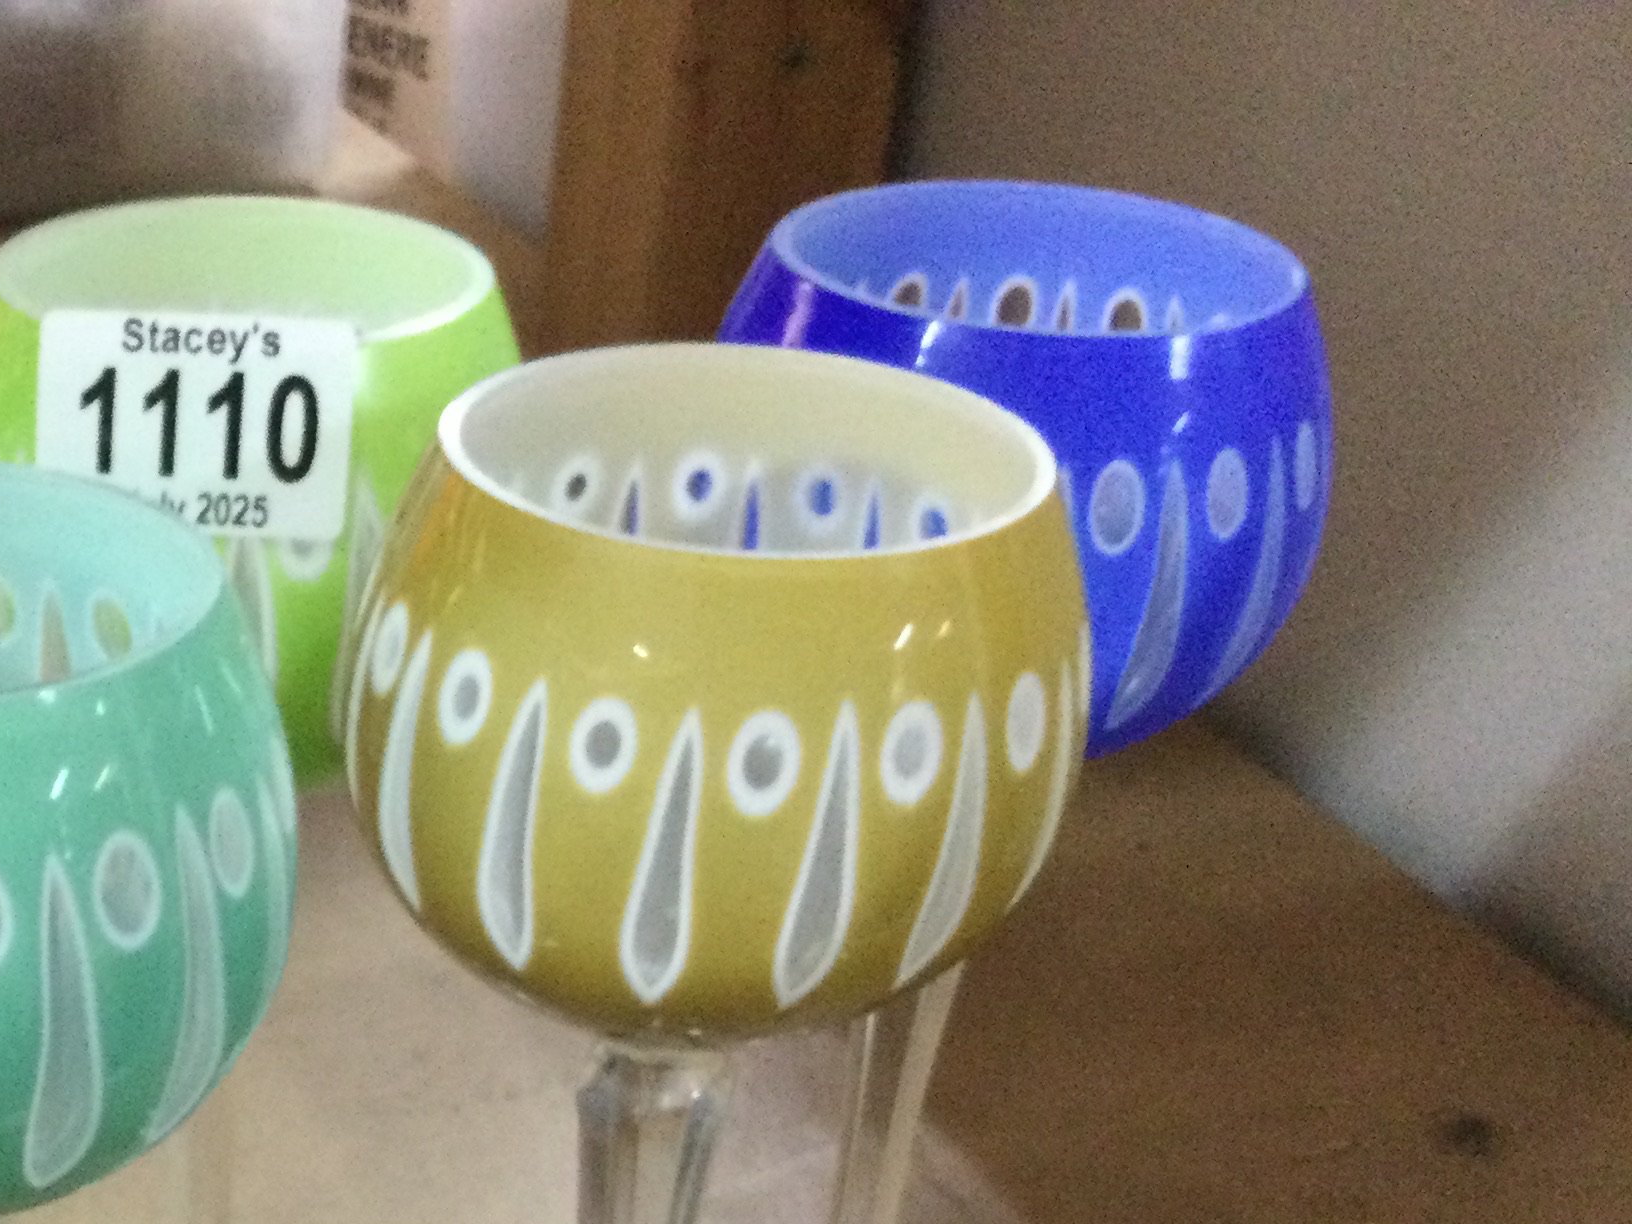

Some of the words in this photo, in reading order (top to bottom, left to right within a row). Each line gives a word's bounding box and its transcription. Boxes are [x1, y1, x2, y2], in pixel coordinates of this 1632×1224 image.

[121, 317, 282, 364] Stacey's
[79, 366, 320, 485] 1110
[195, 491, 269, 529] 2025
